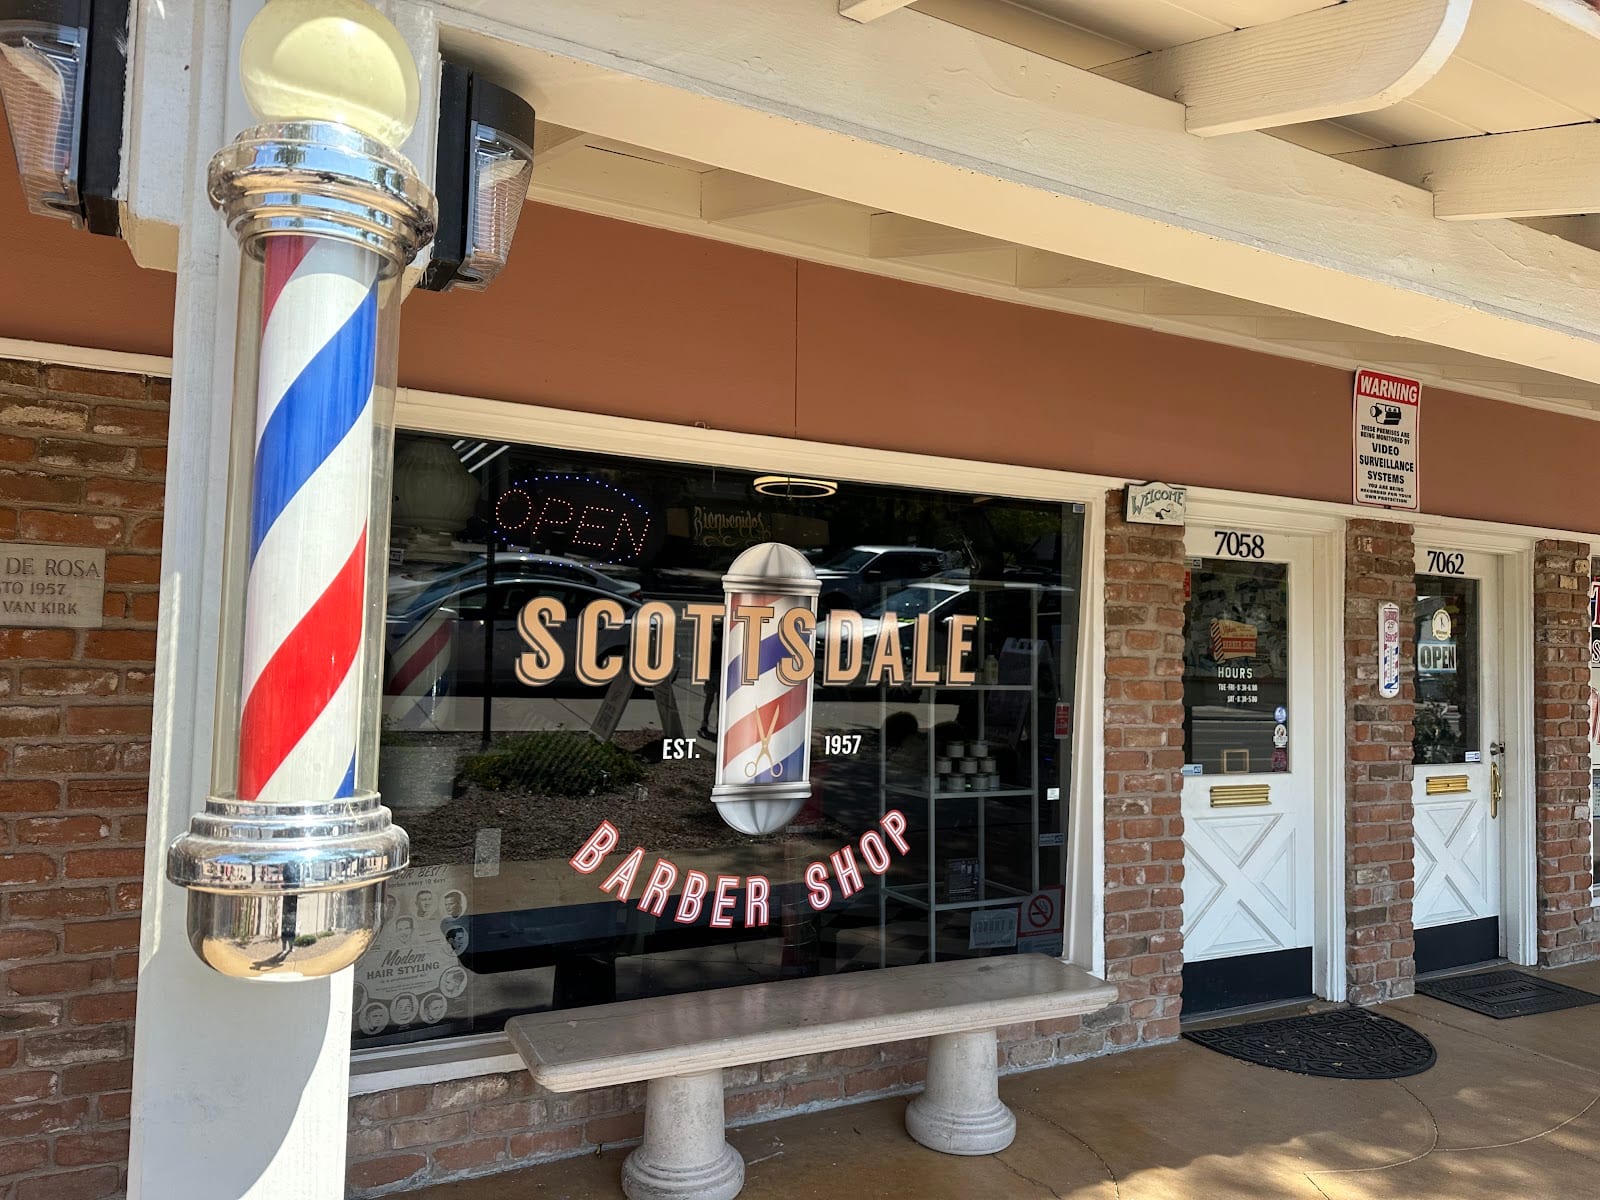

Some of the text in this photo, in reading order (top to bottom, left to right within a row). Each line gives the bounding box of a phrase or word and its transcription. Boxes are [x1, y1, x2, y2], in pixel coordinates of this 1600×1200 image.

[1360, 375, 1418, 403] WARNING
[1360, 431, 1375, 439] BEING
[1376, 434, 1403, 444] MONITORED
[1361, 424, 1410, 439] THESE PREMISES ARE
[1371, 442, 1399, 456] VIDEO
[1359, 454, 1414, 472] SURVEILLANCE
[1367, 470, 1405, 484] SYSTEMS
[1131, 489, 1184, 515] WELCOME
[495, 488, 651, 556] OPEN
[1214, 530, 1265, 559] 7058
[7, 557, 101, 577] DE ROSA
[1427, 550, 1465, 575] 7062
[31, 583, 66, 595] 1957
[3, 601, 78, 615] VAN KIRK
[514, 596, 978, 687] SCOTTSDALE
[1420, 645, 1455, 669] OPEN
[1217, 666, 1253, 679] HOURS
[662, 734, 862, 761] EST. 1957
[568, 809, 911, 928] BARBER SHOP
[381, 949, 426, 967] Modern
[367, 968, 394, 980] HAIR
[397, 961, 440, 975] STYLING
